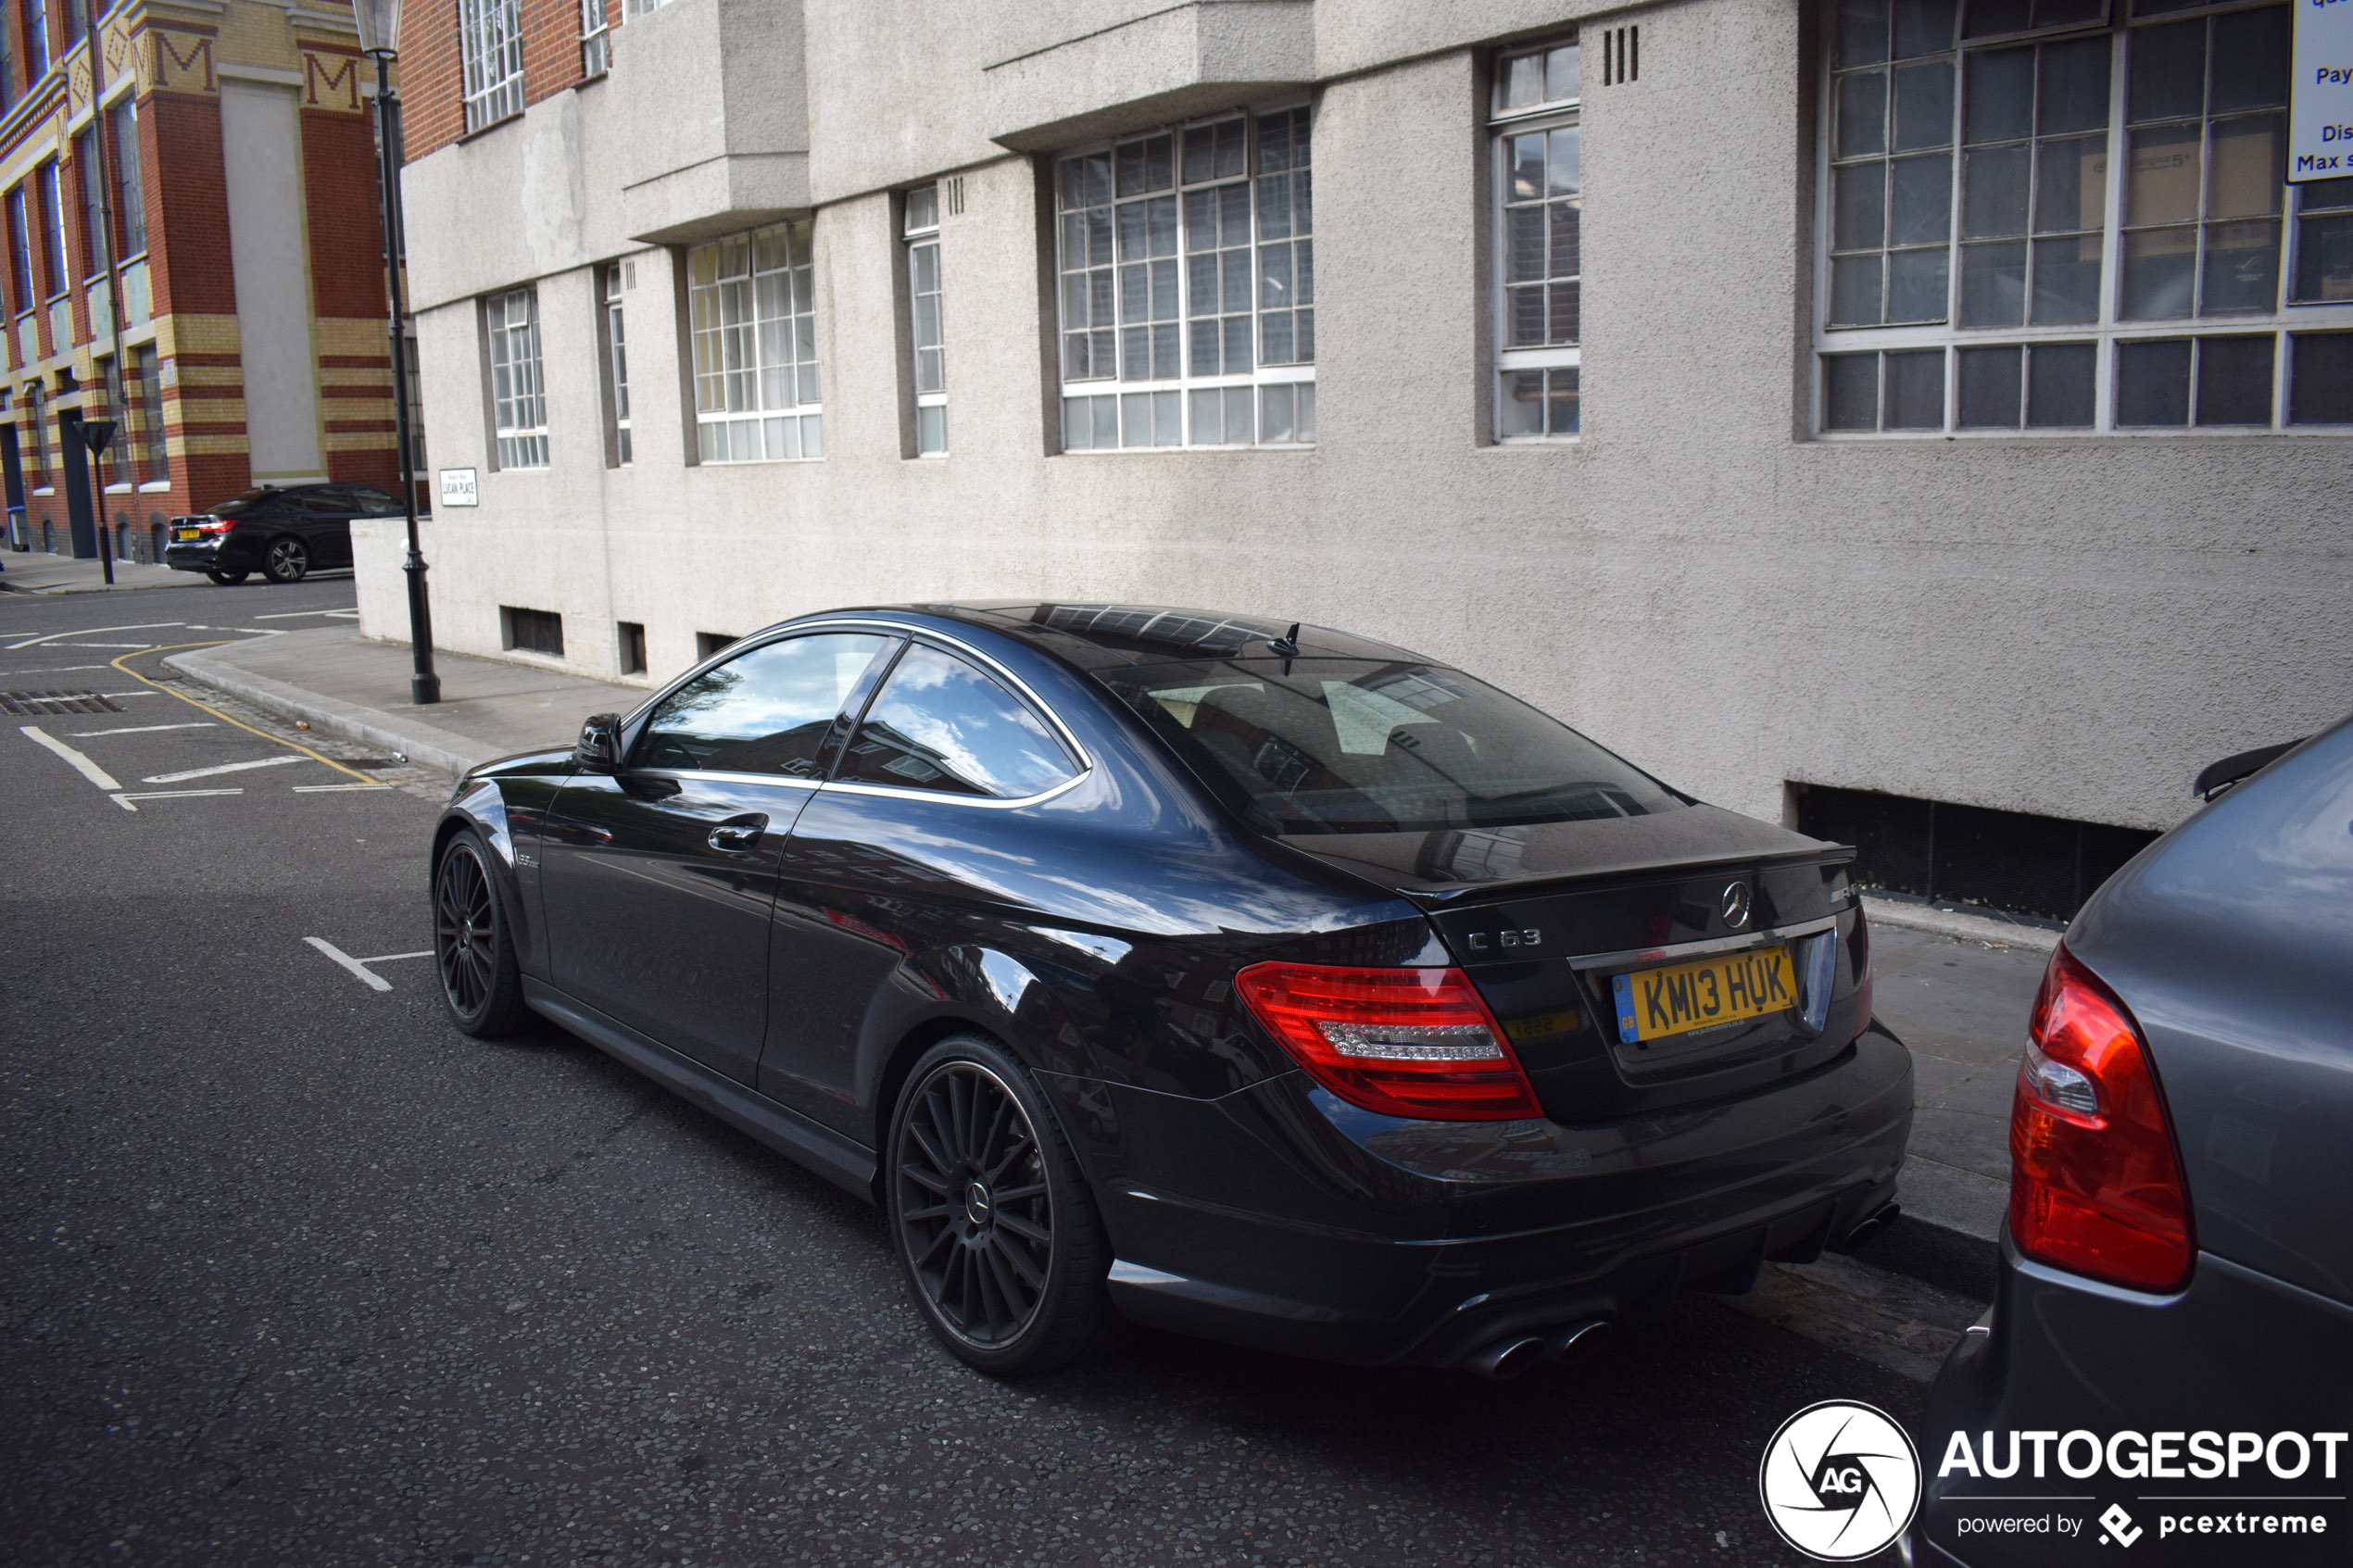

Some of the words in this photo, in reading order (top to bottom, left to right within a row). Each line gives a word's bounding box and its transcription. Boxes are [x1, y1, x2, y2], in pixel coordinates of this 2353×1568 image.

[152, 31, 217, 92] M
[303, 51, 360, 110] M
[2316, 67, 2353, 85] Pay
[2297, 154, 2340, 172] Max
[443, 483, 458, 495] LUCAN
[459, 482, 474, 495] PLACE
[1468, 932, 1489, 950] C
[1501, 928, 1541, 947] 63
[1643, 969, 1721, 1030] KM13
[1725, 955, 1788, 1011] HUK
[1621, 1015, 1635, 1030] GB
